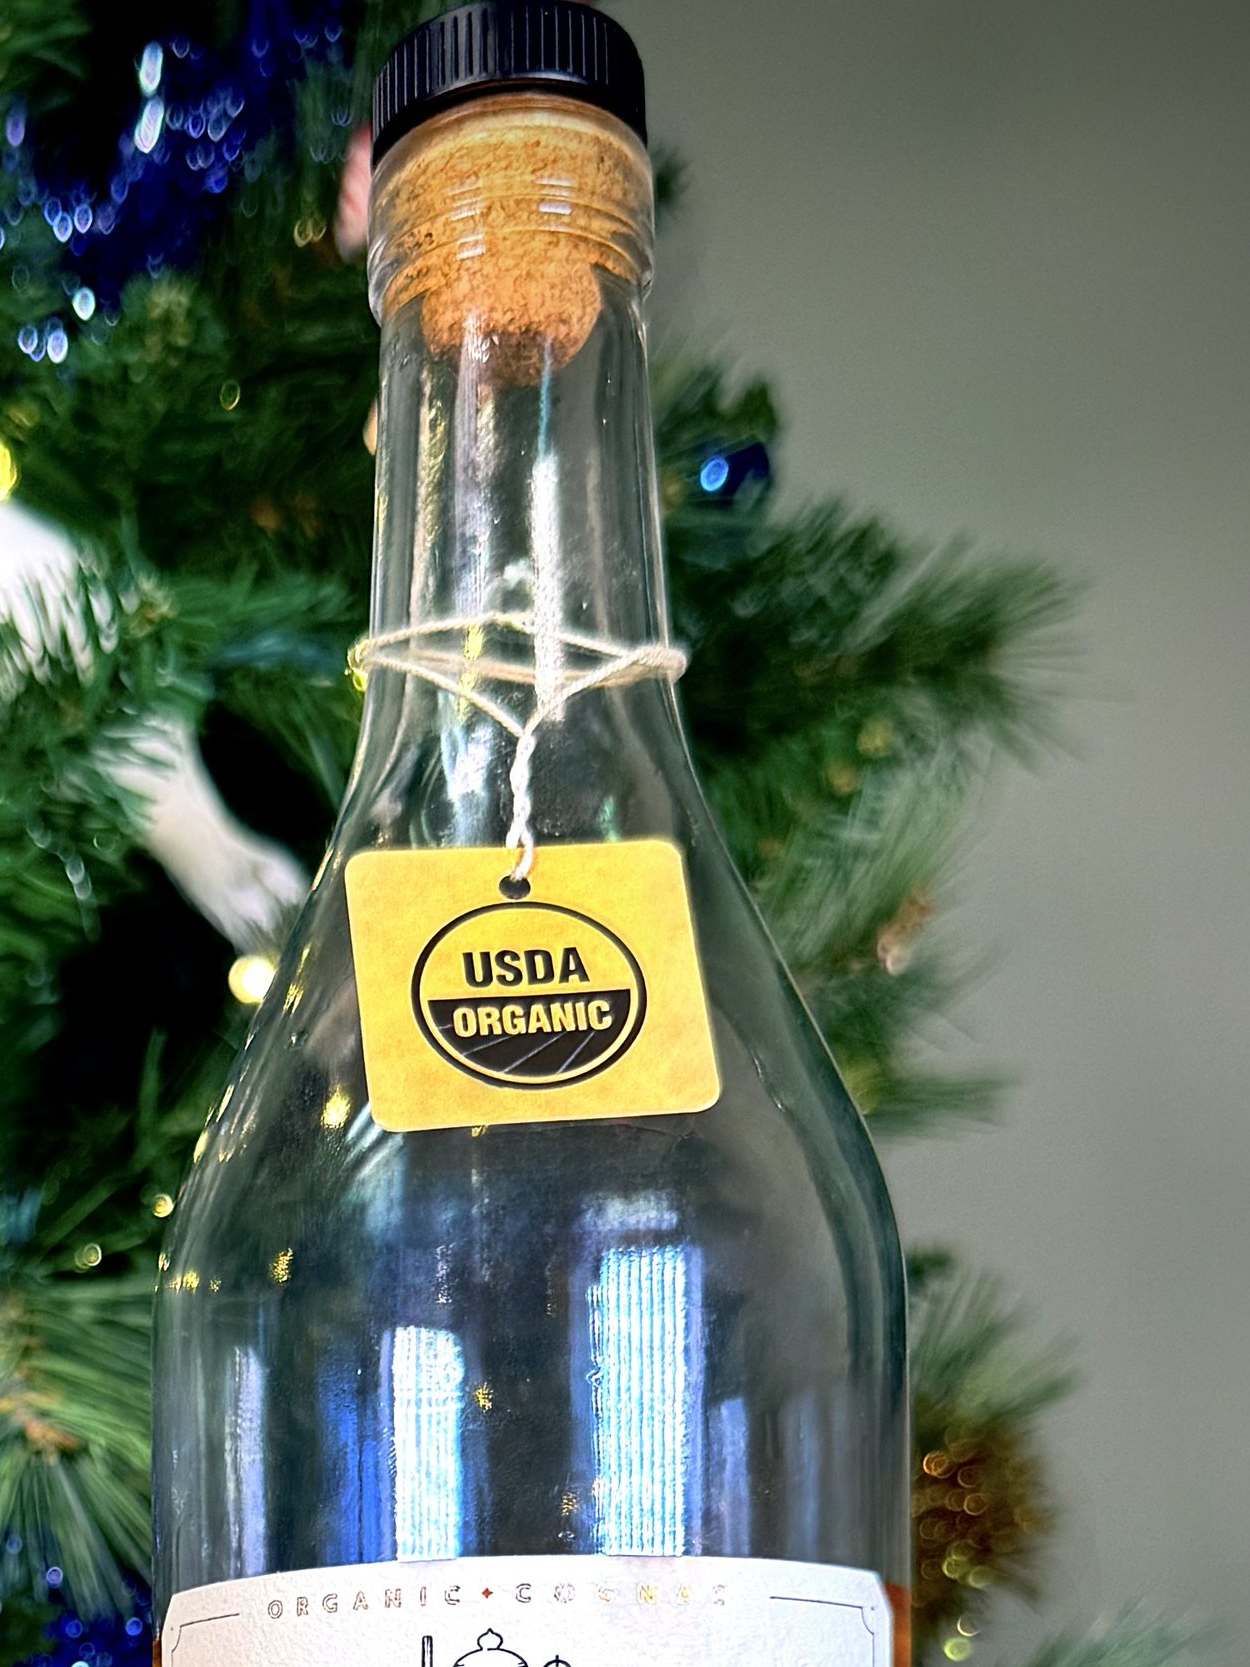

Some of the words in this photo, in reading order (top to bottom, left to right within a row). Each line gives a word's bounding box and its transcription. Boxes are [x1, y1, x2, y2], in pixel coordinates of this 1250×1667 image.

[462, 946, 590, 988] USDA
[452, 999, 613, 1039] ORGANIC
[267, 1585, 461, 1620] ORGANIC
